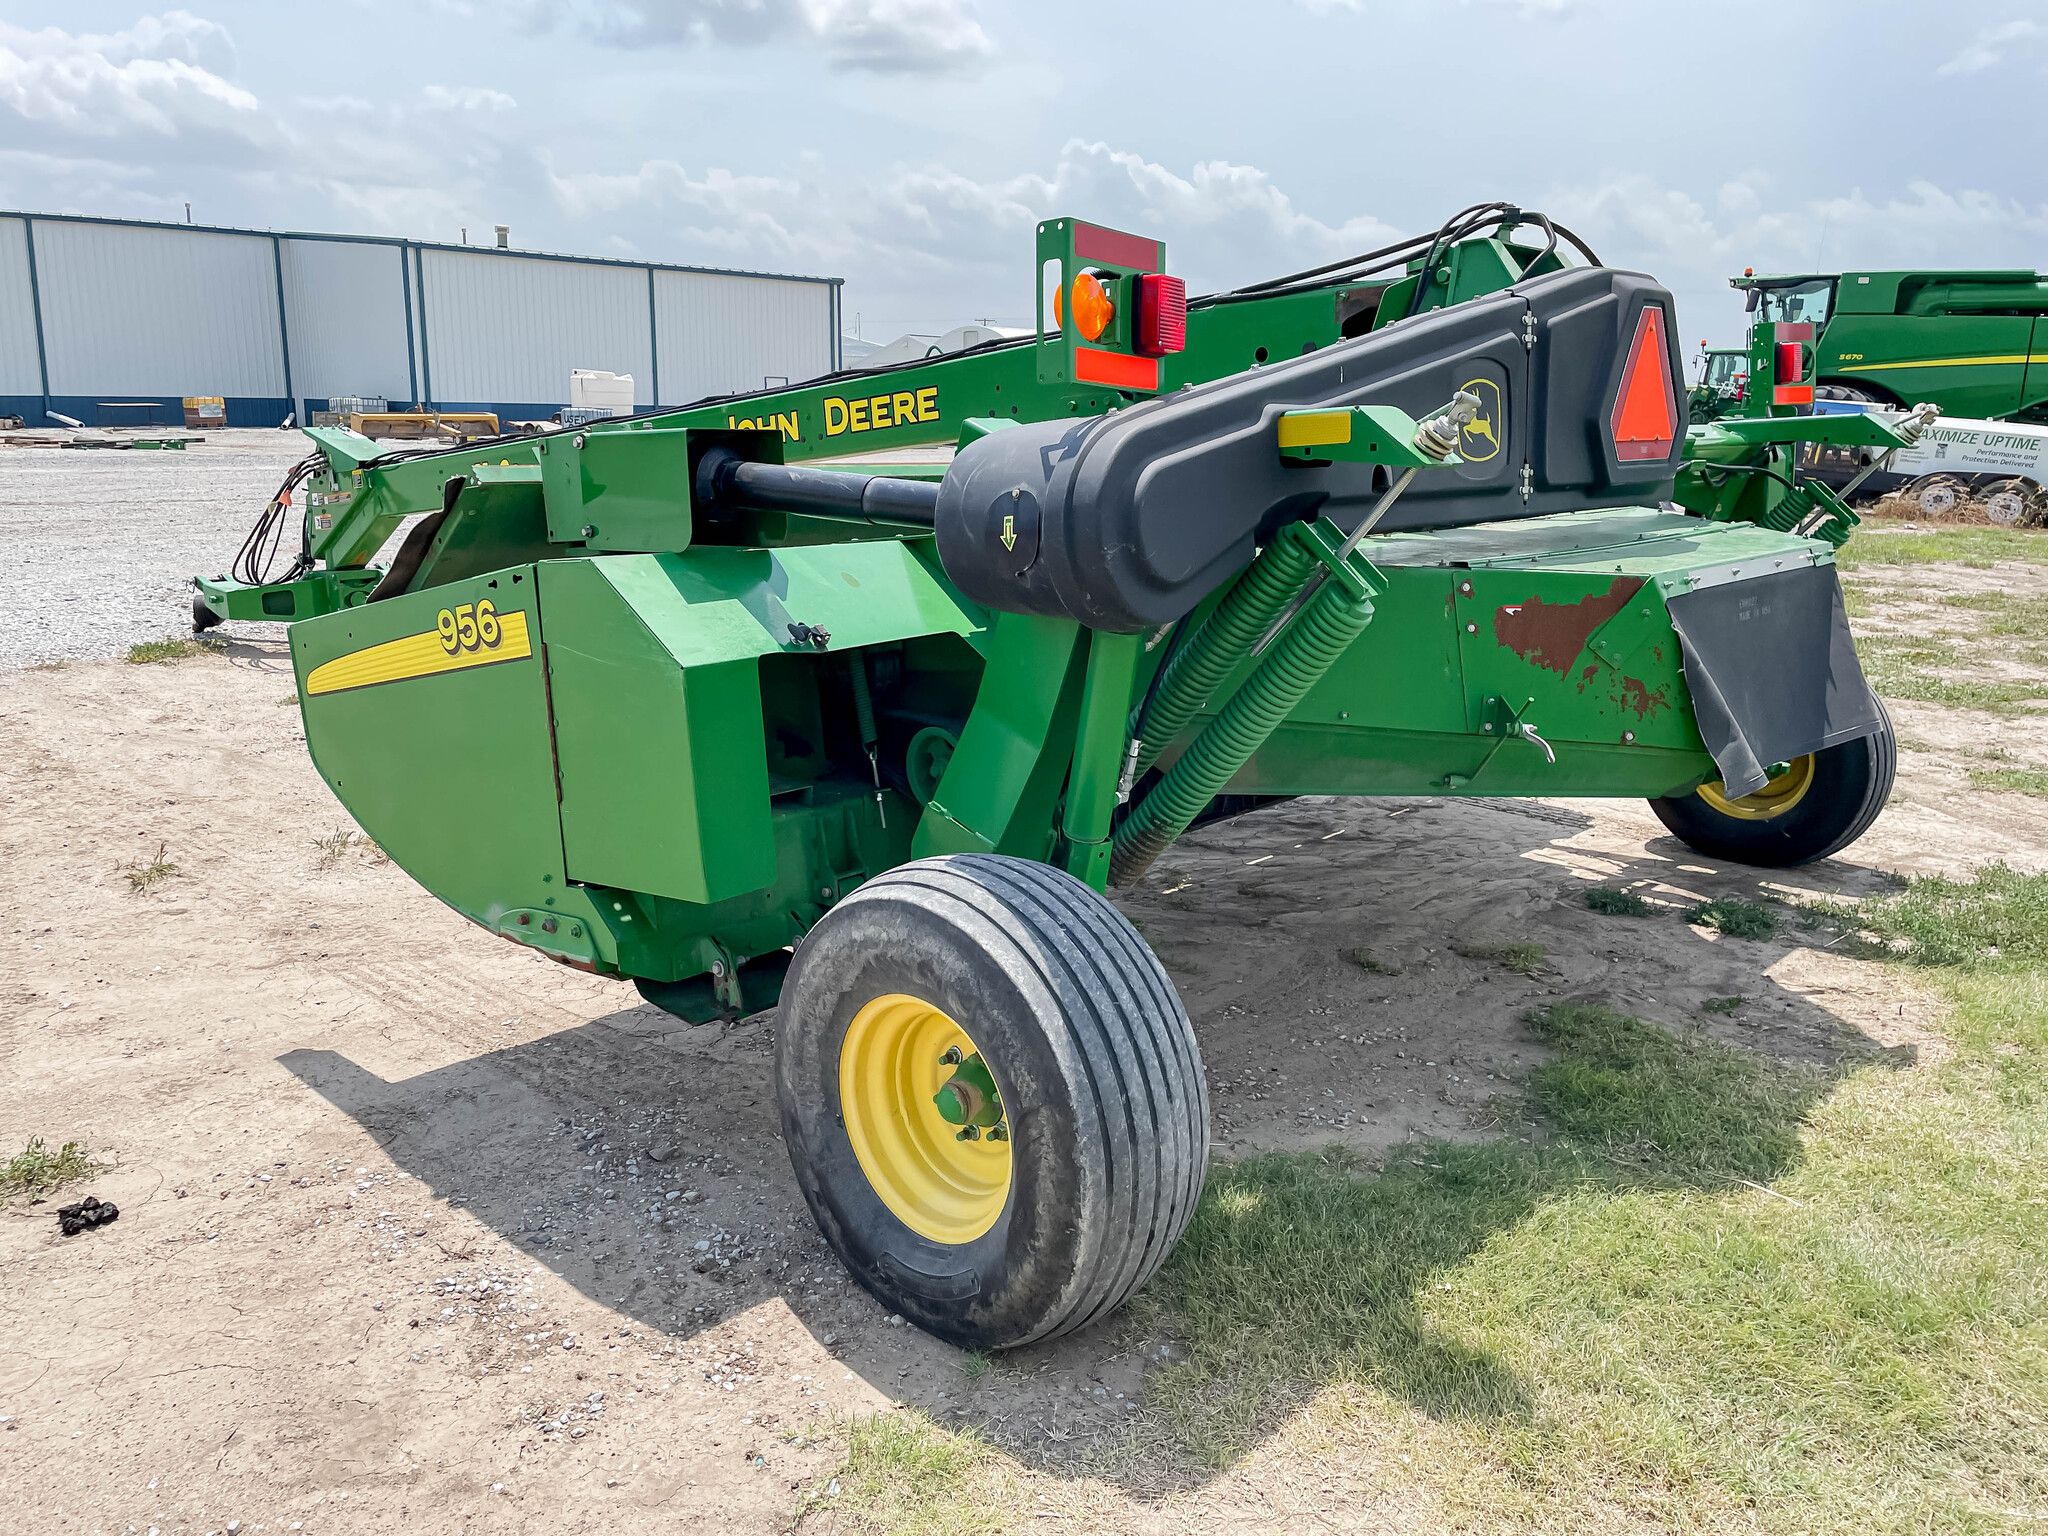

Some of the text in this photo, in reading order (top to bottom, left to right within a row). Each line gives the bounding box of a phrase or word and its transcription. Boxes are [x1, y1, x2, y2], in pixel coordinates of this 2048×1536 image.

[563, 415, 587, 425] USED
[823, 385, 941, 438] DEERE
[1919, 427, 2042, 452] AXIMIZE UPTIME.
[1961, 454, 1999, 465] Protection
[1975, 448, 2022, 459] Performance
[437, 598, 502, 656] 956
